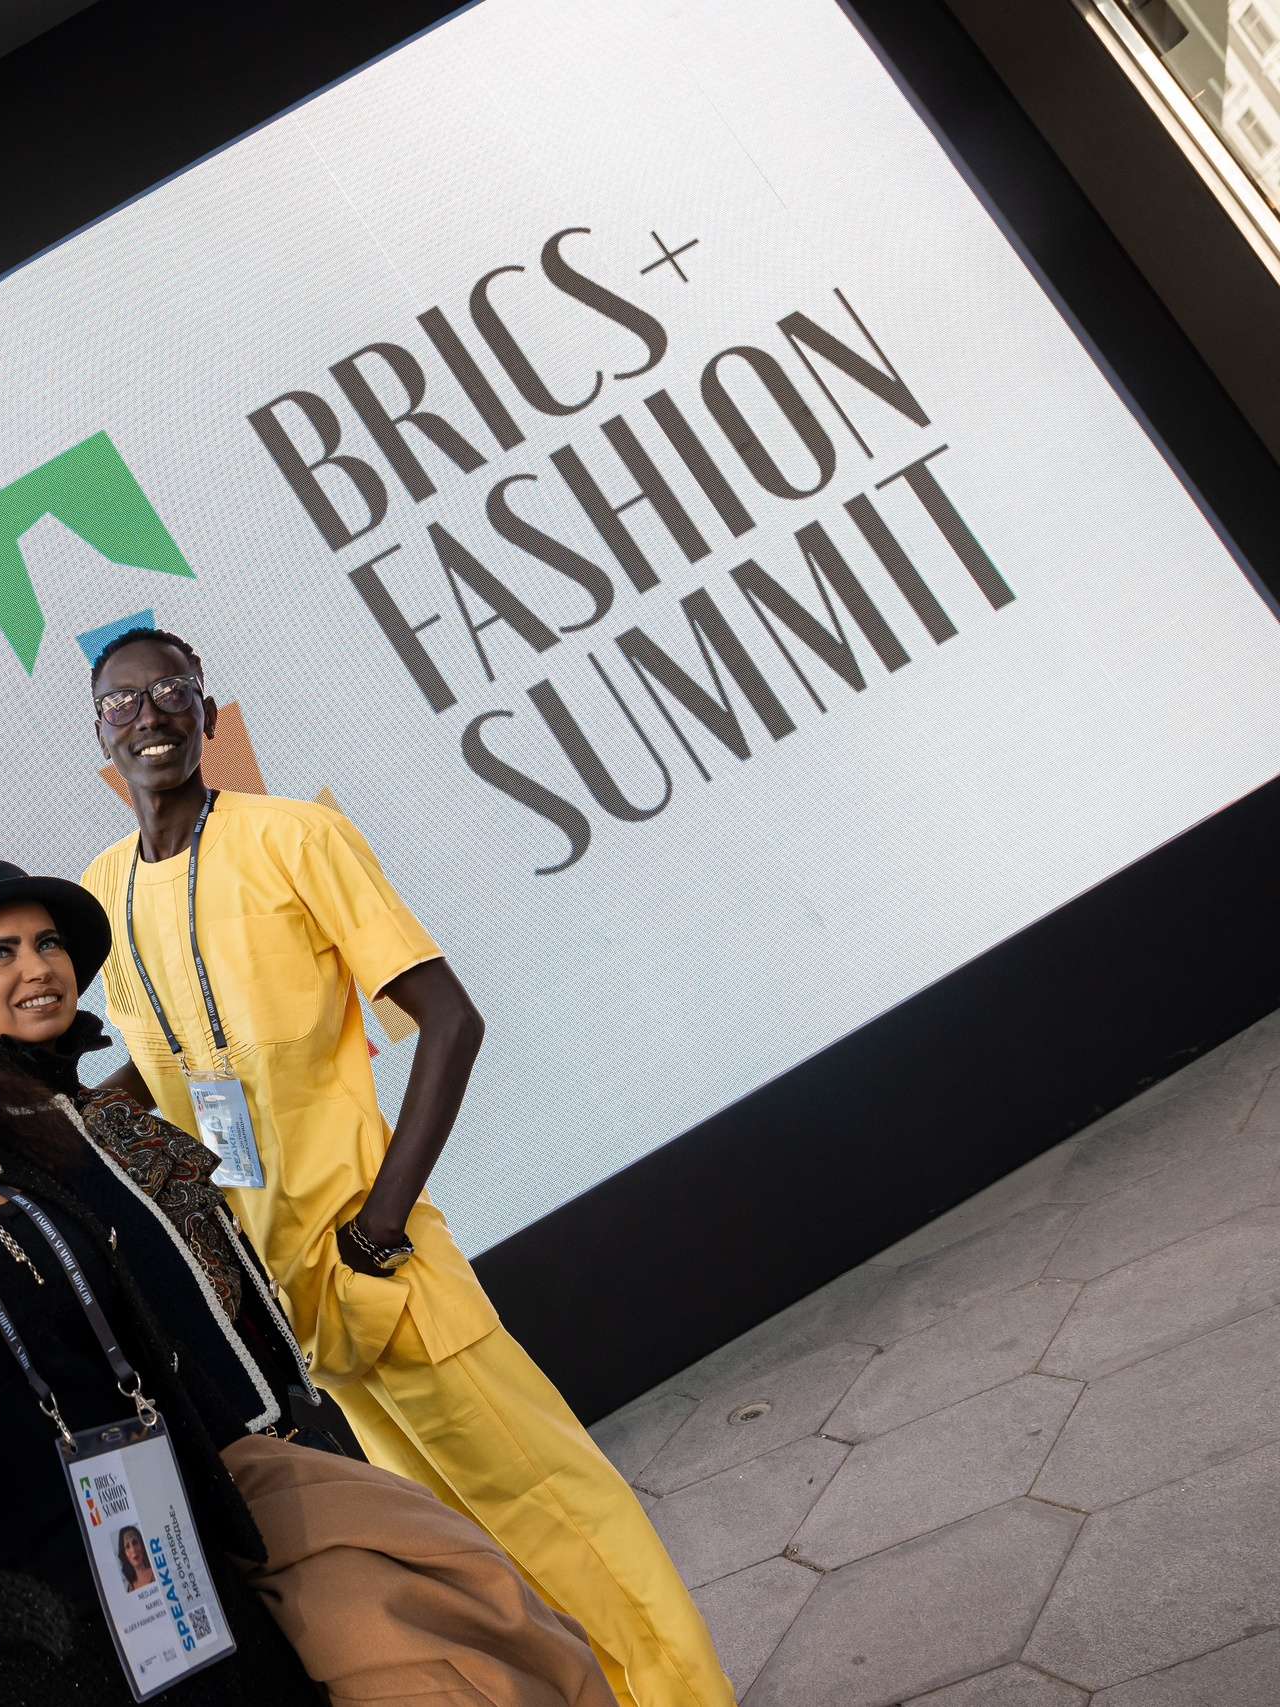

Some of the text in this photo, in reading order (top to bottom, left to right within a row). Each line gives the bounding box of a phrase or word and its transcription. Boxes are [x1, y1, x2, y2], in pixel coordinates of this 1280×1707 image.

[348, 288, 931, 715] FASHION
[461, 443, 1017, 876] SUMMIT
[33, 1212, 57, 1240] FASHION
[54, 1240, 76, 1270] SUMMIT
[72, 1271, 93, 1305] MOSCOW
[98, 1484, 127, 1504] FASHION
[102, 1497, 130, 1518] SUMMIT
[164, 1524, 185, 1579] ОКТЯБРЯ
[145, 1599, 163, 1611] NAWEL
[149, 1536, 196, 1652] SPEAKER
[188, 1572, 201, 1598] МКЗ
[137, 1615, 155, 1626] FASHION
[155, 1609, 166, 1619] WEEK
